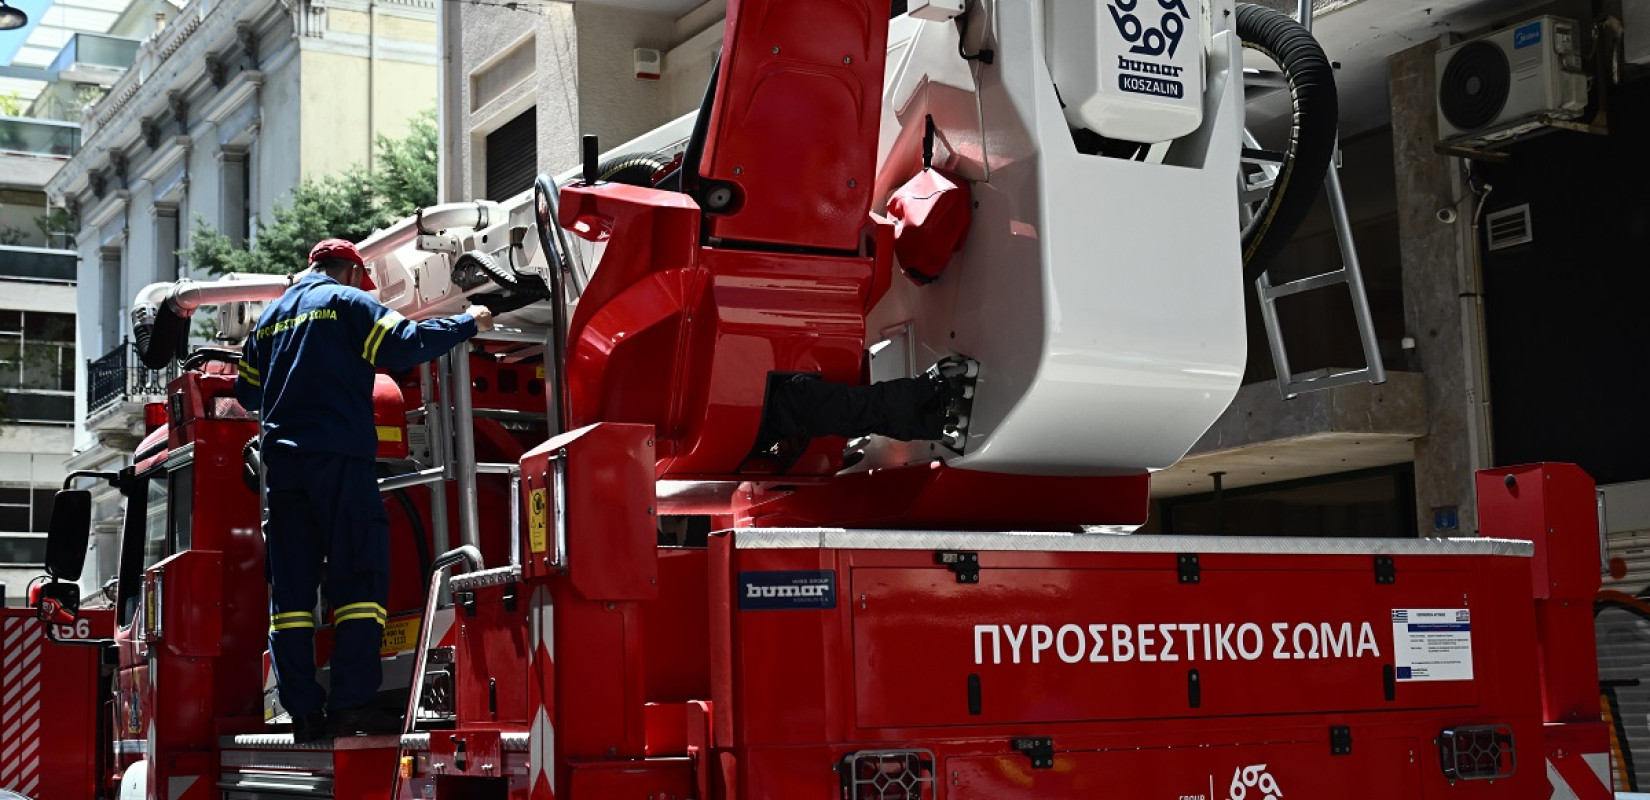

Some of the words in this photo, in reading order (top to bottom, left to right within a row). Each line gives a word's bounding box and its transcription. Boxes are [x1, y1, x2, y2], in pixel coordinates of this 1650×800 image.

[1118, 55, 1183, 78] bumar
[1123, 76, 1179, 96] KOSZALIN
[309, 308, 338, 321] ΣΩΜΑ
[746, 583, 829, 598] bumar
[974, 623, 1264, 664] ΠΥΡΟΣΒΕΣΤΙΚΟ
[1271, 622, 1380, 660] ΣΩΜΑ
